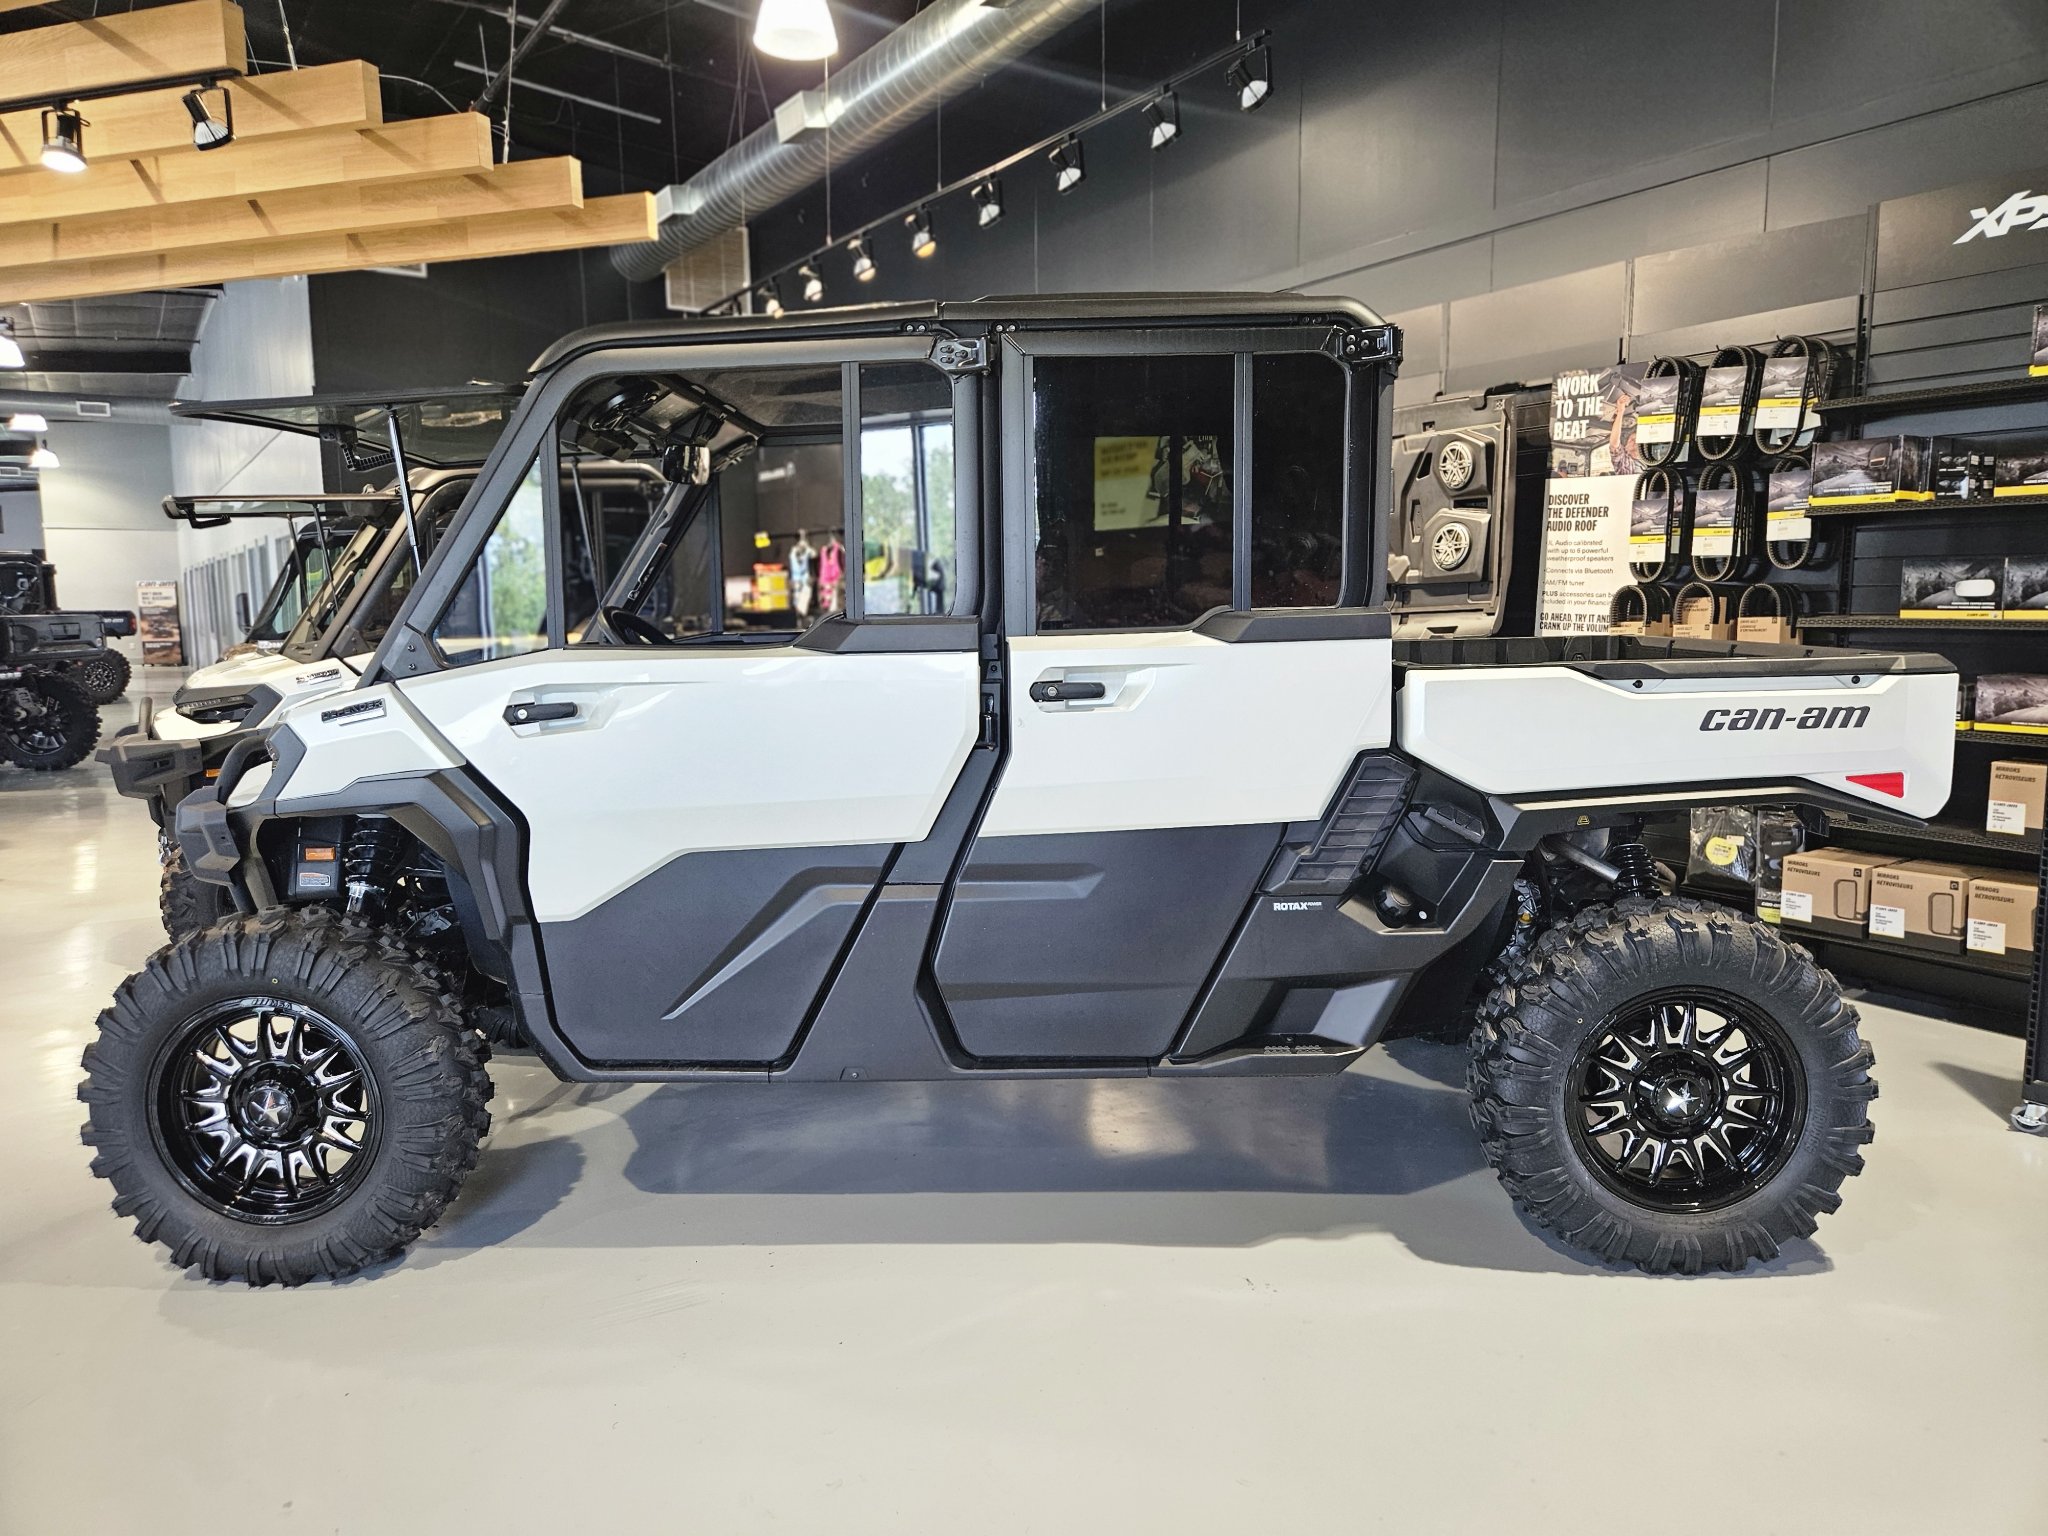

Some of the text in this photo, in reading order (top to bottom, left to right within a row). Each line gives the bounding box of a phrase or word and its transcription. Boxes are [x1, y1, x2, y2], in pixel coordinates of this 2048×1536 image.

[1556, 373, 1601, 397] WORK
[1555, 395, 1605, 419] TO THE
[1553, 419, 1590, 441] BEAT
[1548, 493, 1590, 506] DISCOVER
[1547, 506, 1610, 518] THE DEFENDER
[1546, 519, 1598, 532] AUDIO ROOF
[1581, 547, 1609, 555] powerful
[1540, 612, 1611, 623] GO AHEAD, TRY IT AND
[1539, 621, 1563, 630] CRANK
[1562, 622, 1572, 631] UP
[1572, 622, 1585, 632] THE
[1586, 623, 1609, 633] VOLUM
[320, 697, 385, 722] DEFENDER
[1699, 705, 1871, 732] can-am
[1995, 766, 2021, 774] MIRRORS
[1787, 860, 1809, 868] MIRRORS
[1876, 872, 1900, 880] MIRRORS
[1974, 885, 2000, 894] MIRRORS
[1273, 901, 1309, 911] ROTAX
